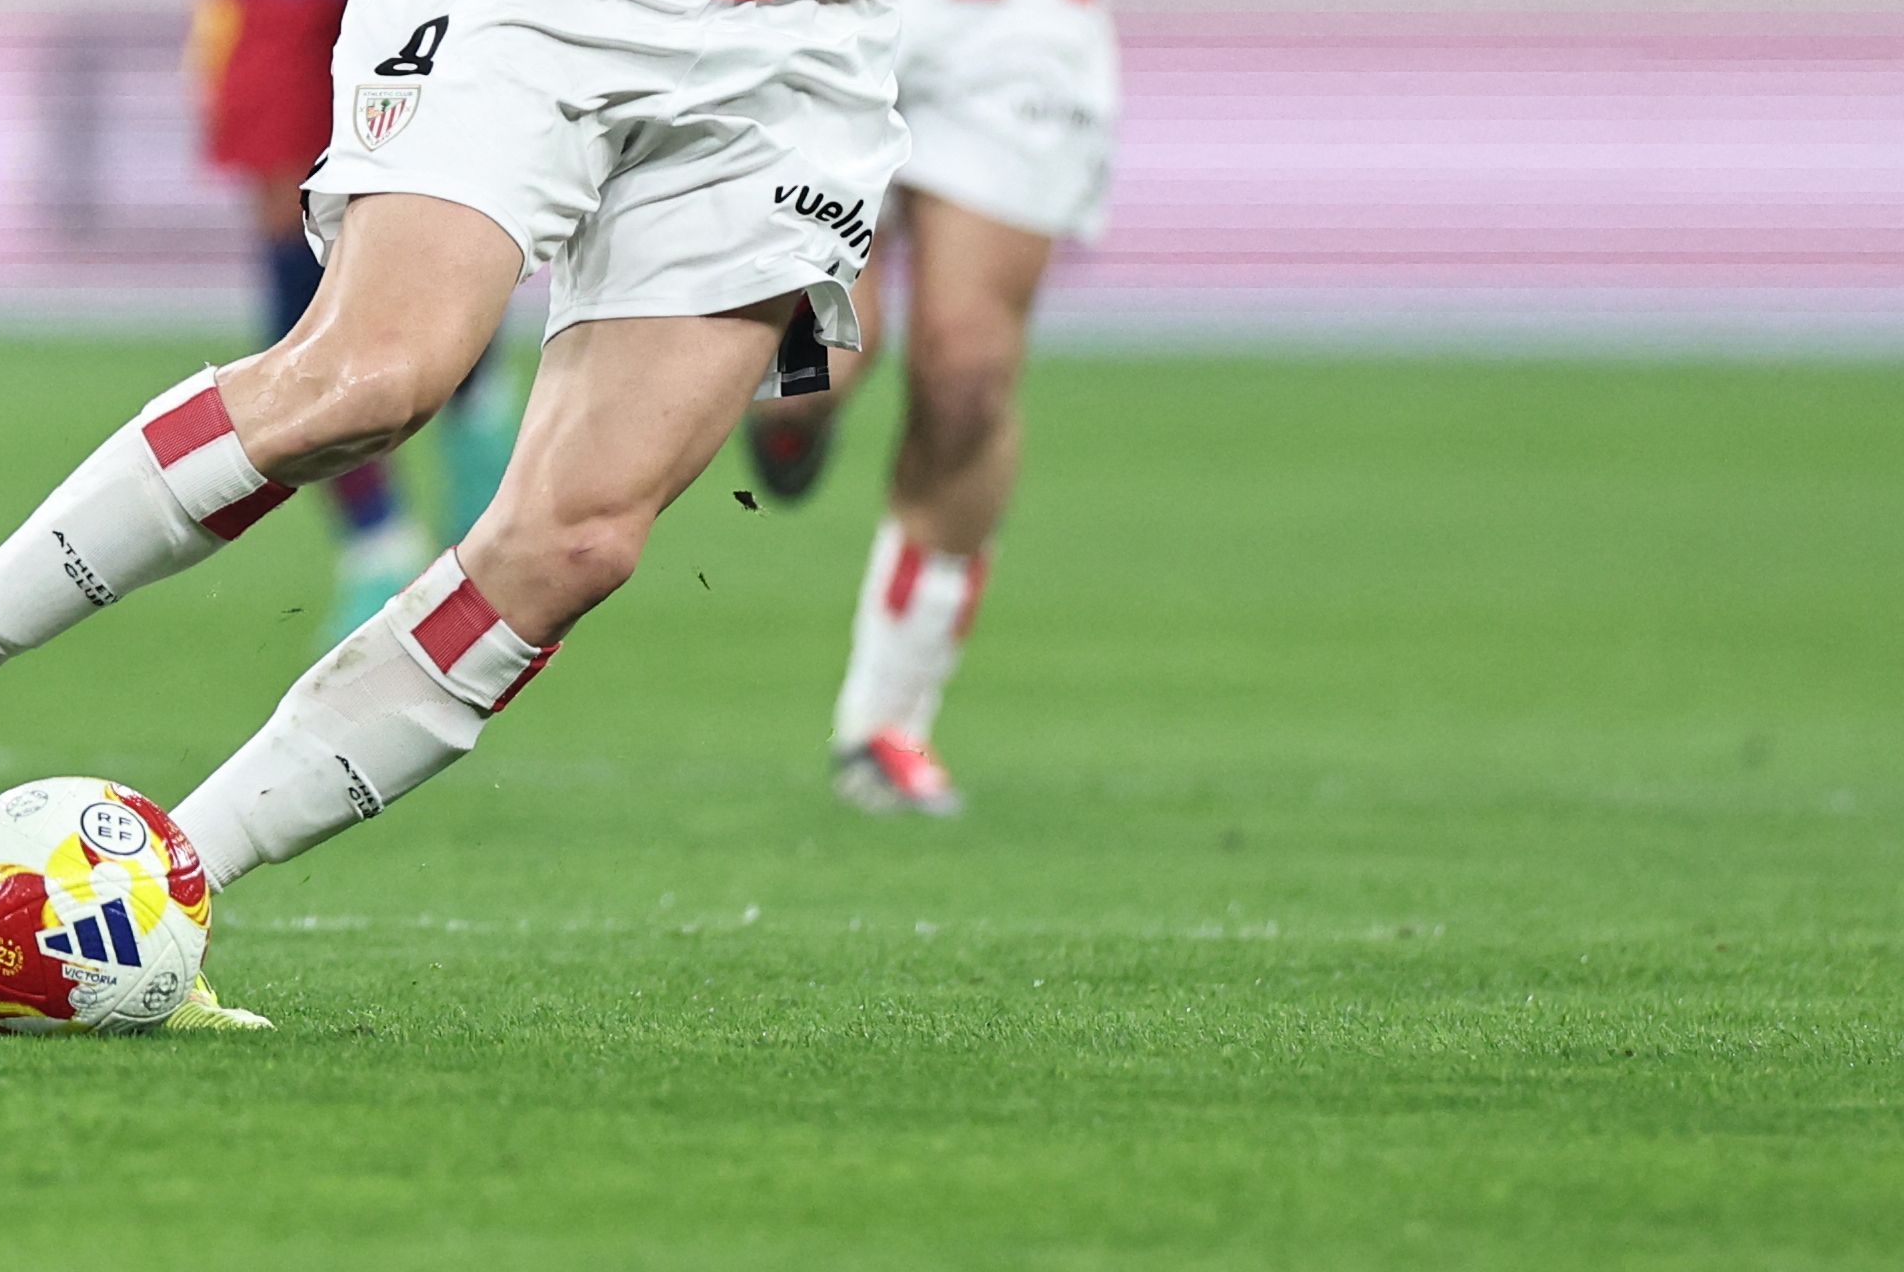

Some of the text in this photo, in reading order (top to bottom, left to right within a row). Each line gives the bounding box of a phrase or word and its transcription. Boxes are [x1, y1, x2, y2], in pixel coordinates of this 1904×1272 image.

[774, 184, 873, 259] vuelin
[63, 562, 105, 607] CLUB
[64, 966, 118, 985] VICTORIA
